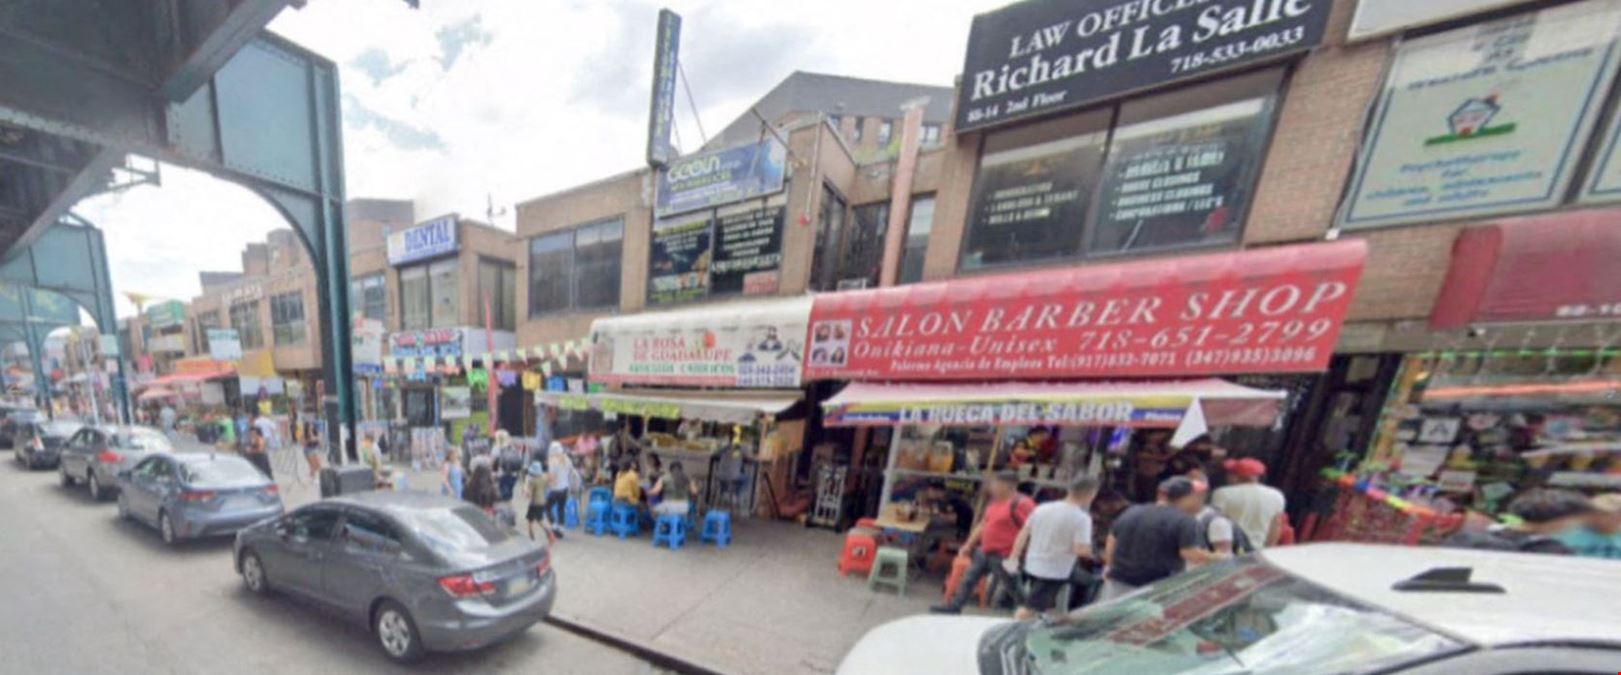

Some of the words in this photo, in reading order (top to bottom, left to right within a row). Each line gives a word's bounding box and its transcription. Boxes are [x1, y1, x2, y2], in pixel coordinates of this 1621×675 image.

[1009, 20, 1072, 59] LAW
[1077, 0, 1206, 37] OFFIC
[971, 31, 1121, 101] Richard
[1127, 24, 1182, 60] La
[1006, 97, 1029, 114] 2nd
[1032, 90, 1068, 107] Floor
[405, 220, 449, 252] DENTAL
[857, 308, 973, 338] SALON
[979, 296, 1163, 334] BARBER
[1180, 281, 1346, 321] SHOP
[633, 338, 648, 349] LA
[652, 337, 686, 348] ROSA
[1080, 319, 1332, 350] 718-651-2799
[651, 348, 733, 361] GUADALUPE
[978, 357, 991, 369] de
[900, 406, 923, 422] LA
[999, 402, 1040, 422] DEL
[1046, 401, 1134, 422] SABOR
